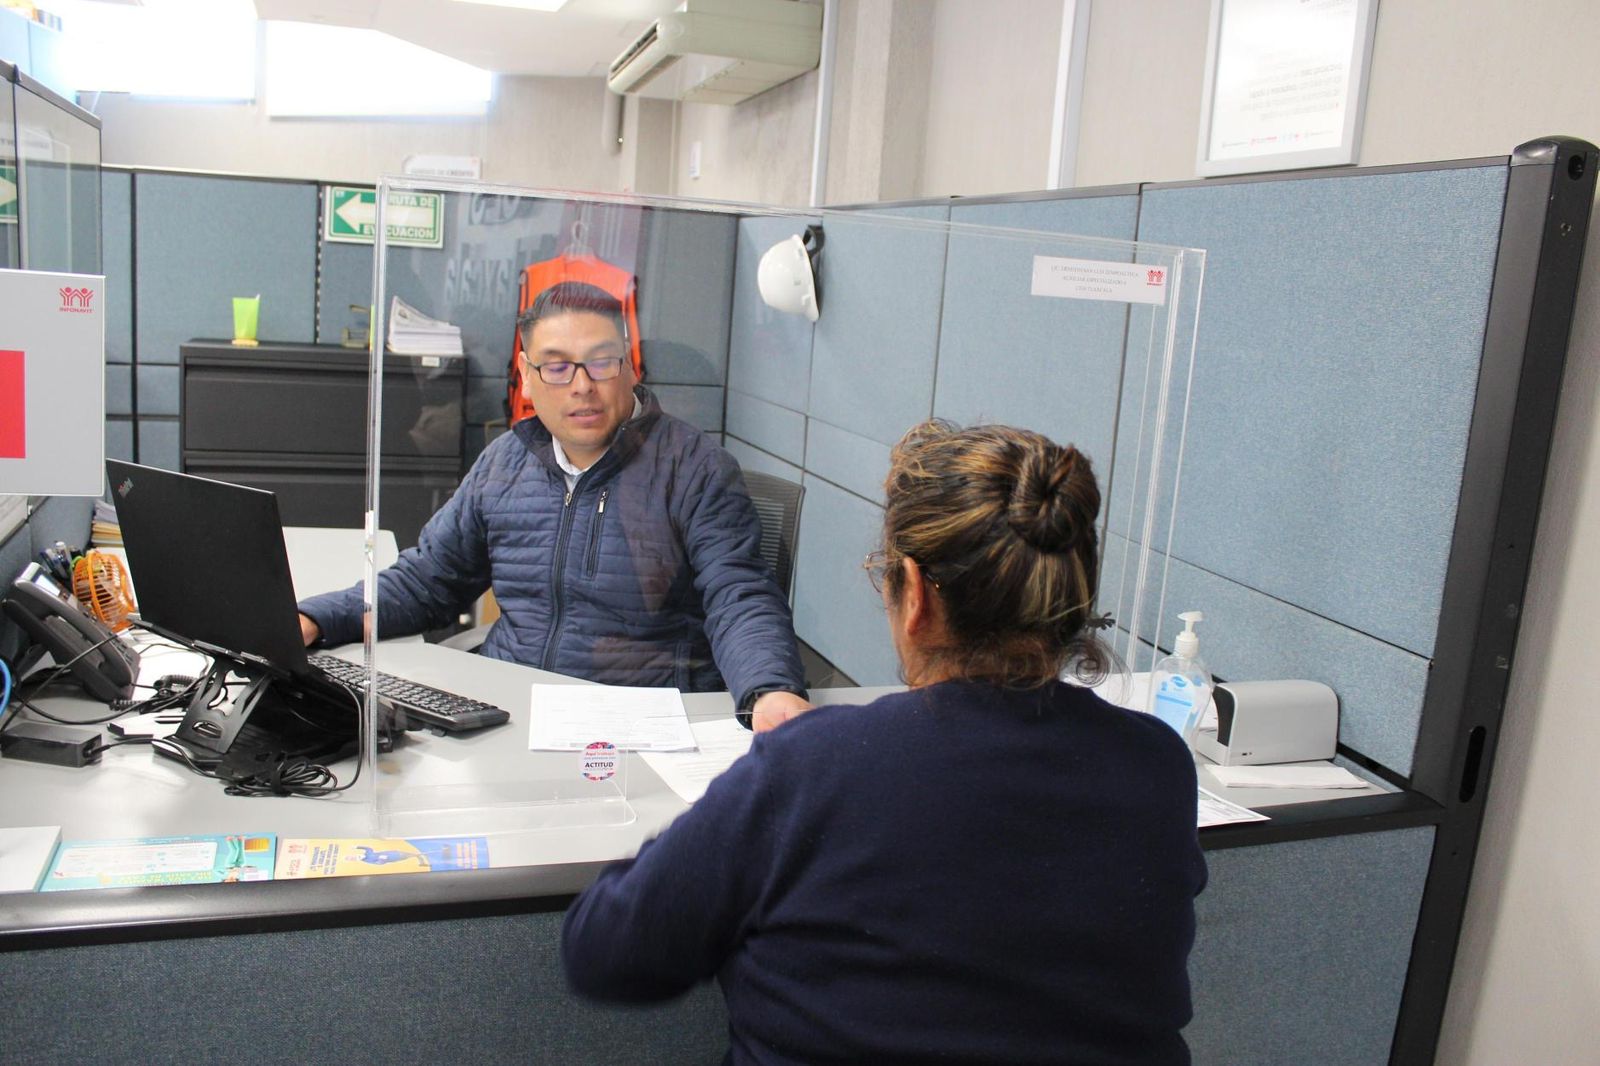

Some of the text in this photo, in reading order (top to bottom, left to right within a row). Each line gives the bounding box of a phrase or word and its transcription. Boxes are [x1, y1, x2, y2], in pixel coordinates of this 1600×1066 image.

[388, 195, 435, 208] RUTA DE
[363, 224, 434, 239] EVCUACION
